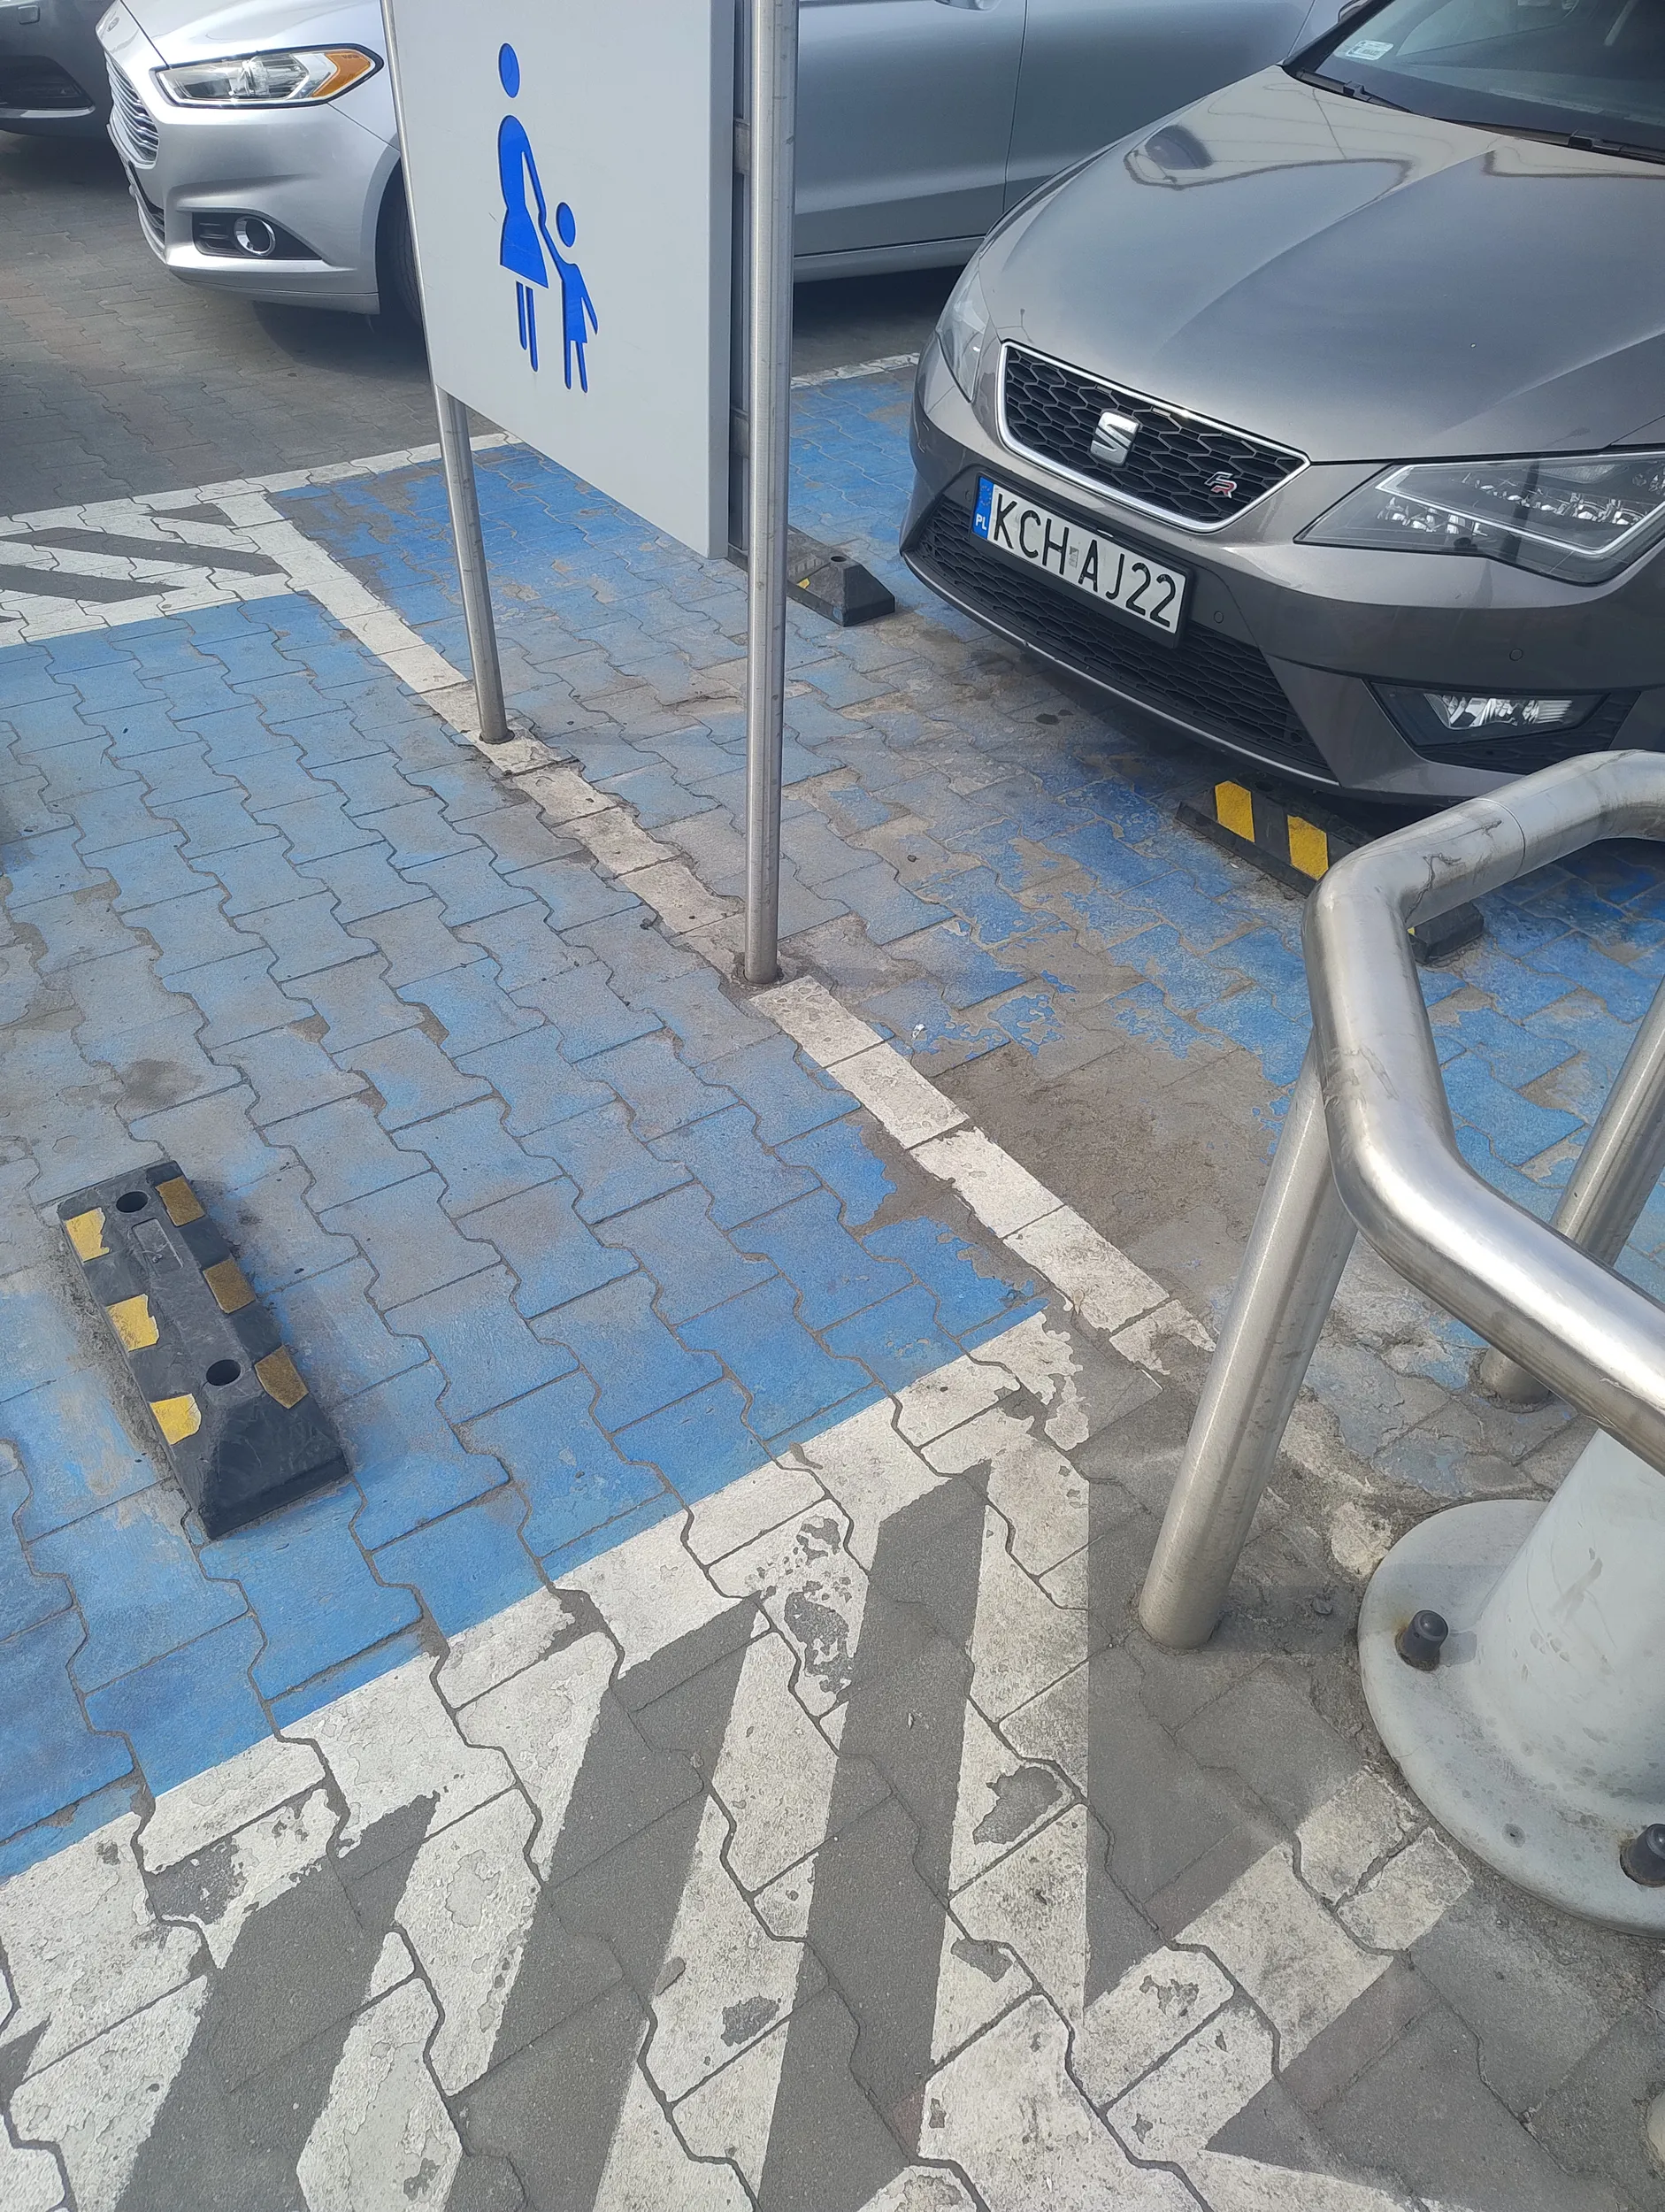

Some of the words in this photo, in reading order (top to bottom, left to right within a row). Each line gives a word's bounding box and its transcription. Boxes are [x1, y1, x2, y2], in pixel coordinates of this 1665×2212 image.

[976, 513, 987, 531] PL
[994, 493, 1070, 575] KCH
[1078, 539, 1177, 627] AJ22
